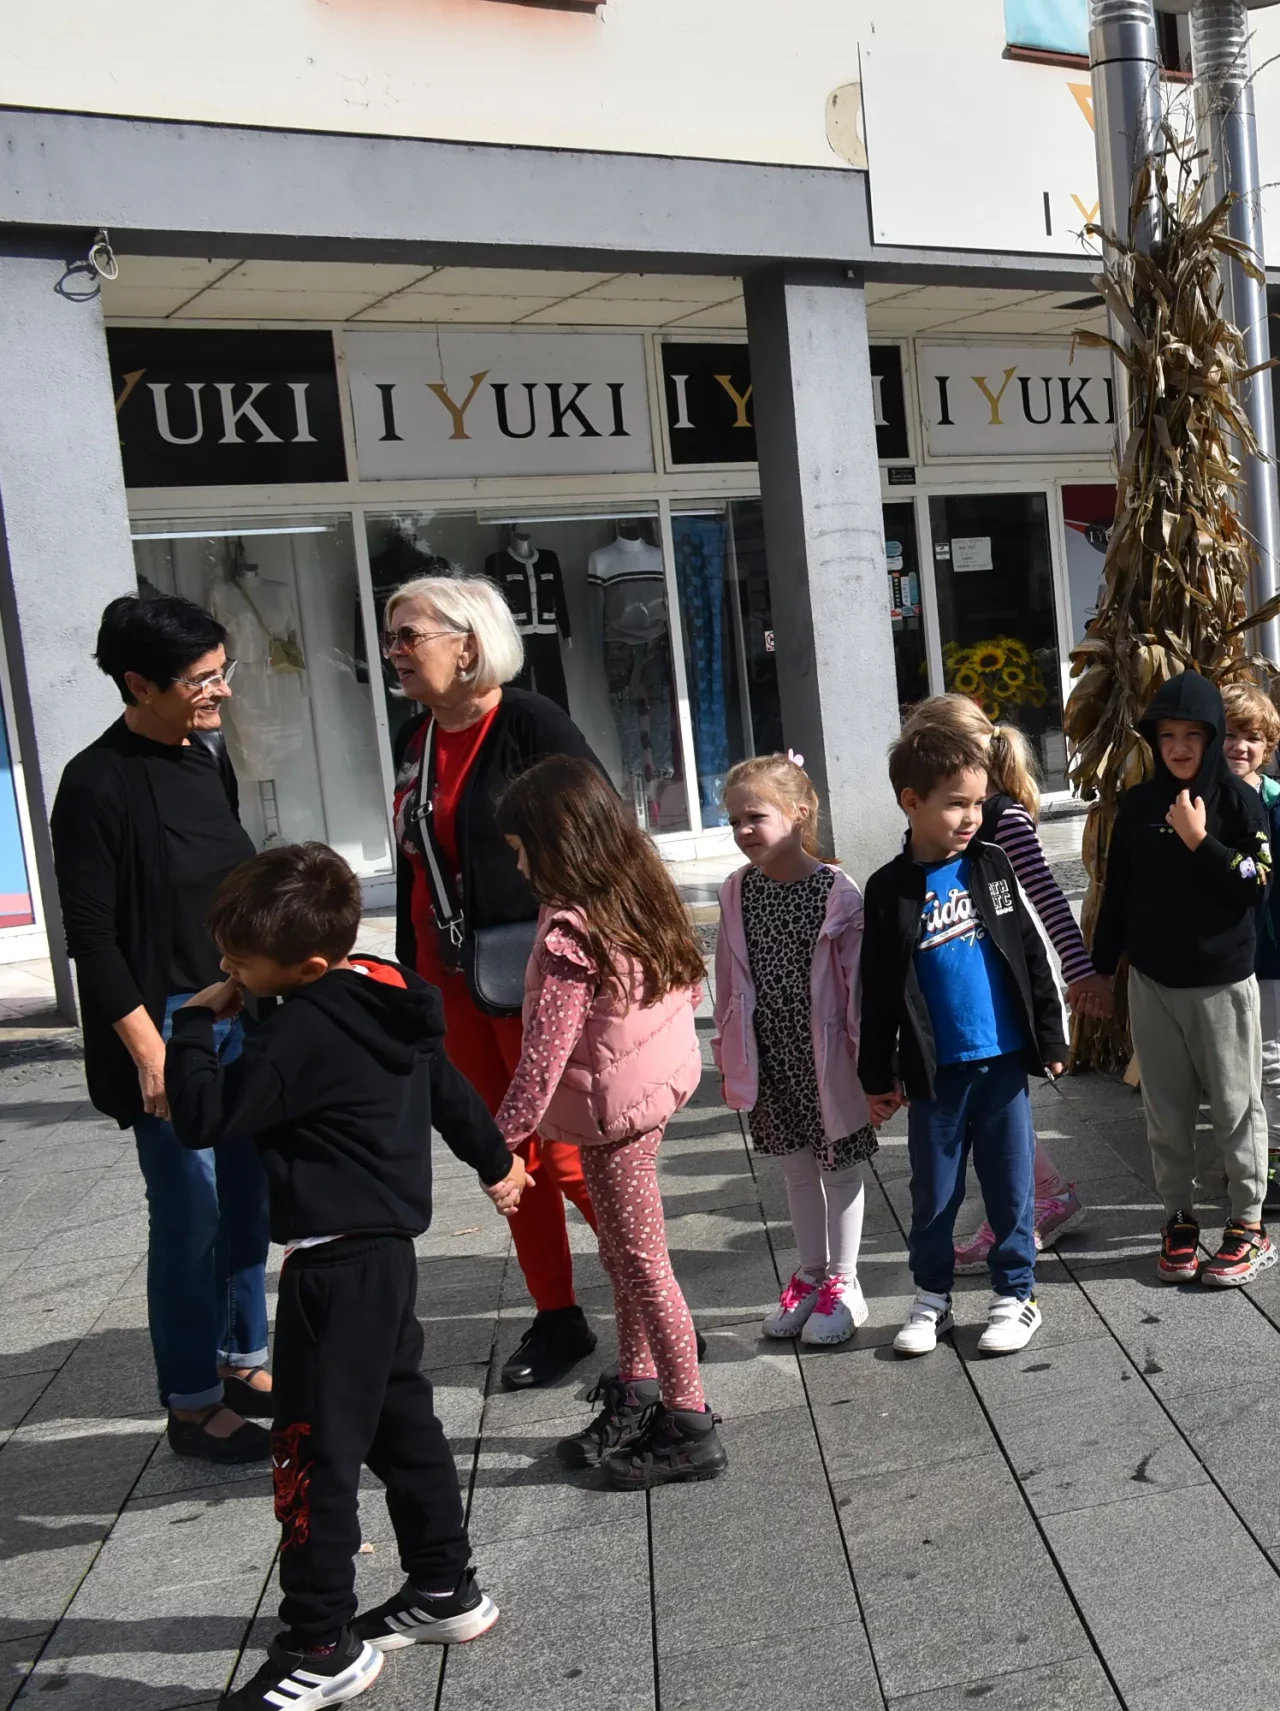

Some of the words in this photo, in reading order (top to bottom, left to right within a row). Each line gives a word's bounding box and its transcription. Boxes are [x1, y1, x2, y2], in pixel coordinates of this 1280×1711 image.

[375, 384, 404, 441] I
[425, 369, 631, 439] YUKI
[670, 375, 696, 428] I
[934, 376, 955, 425] I
[971, 365, 1115, 425] YUKI
